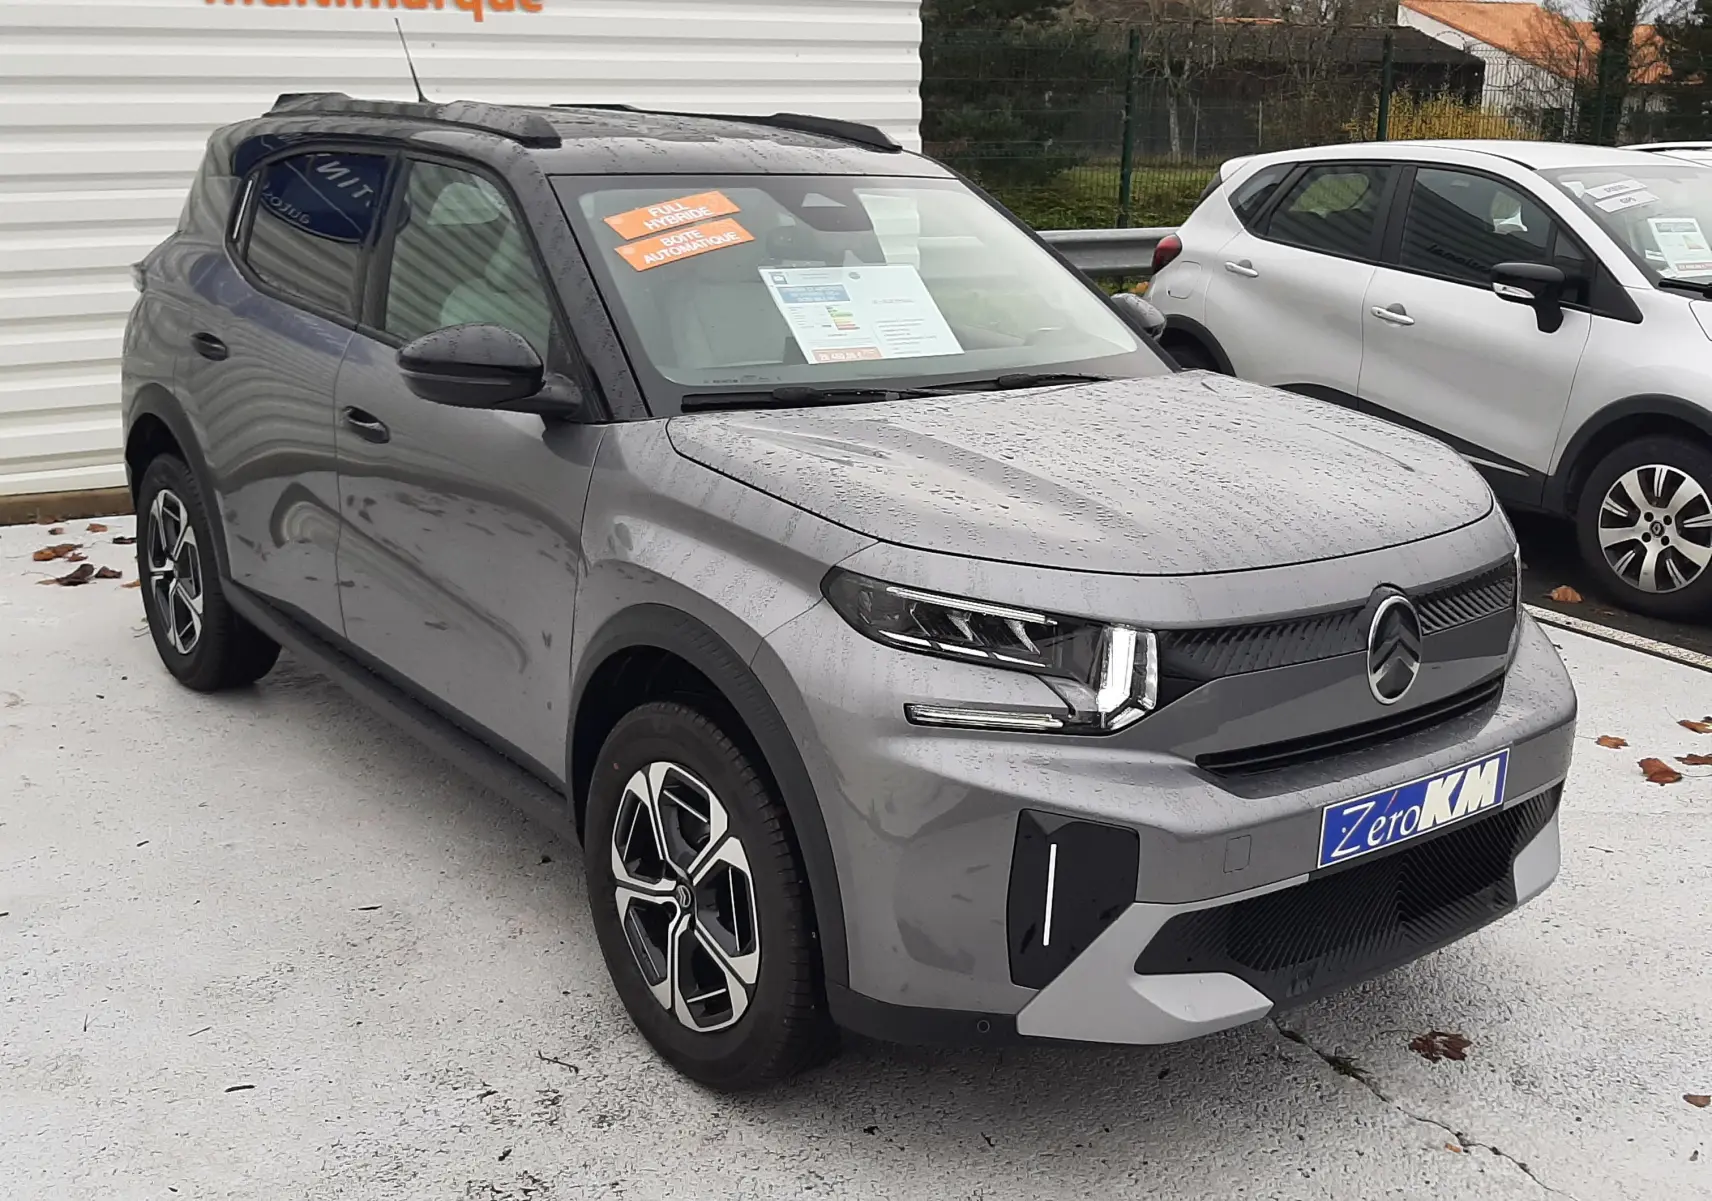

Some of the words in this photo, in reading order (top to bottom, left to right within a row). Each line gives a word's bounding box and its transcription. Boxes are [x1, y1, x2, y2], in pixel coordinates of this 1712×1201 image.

[642, 206, 715, 231] HYBRIDE
[648, 201, 690, 217] FULL
[643, 231, 741, 265] AUTOMATIQUE
[660, 229, 704, 247] BOITE
